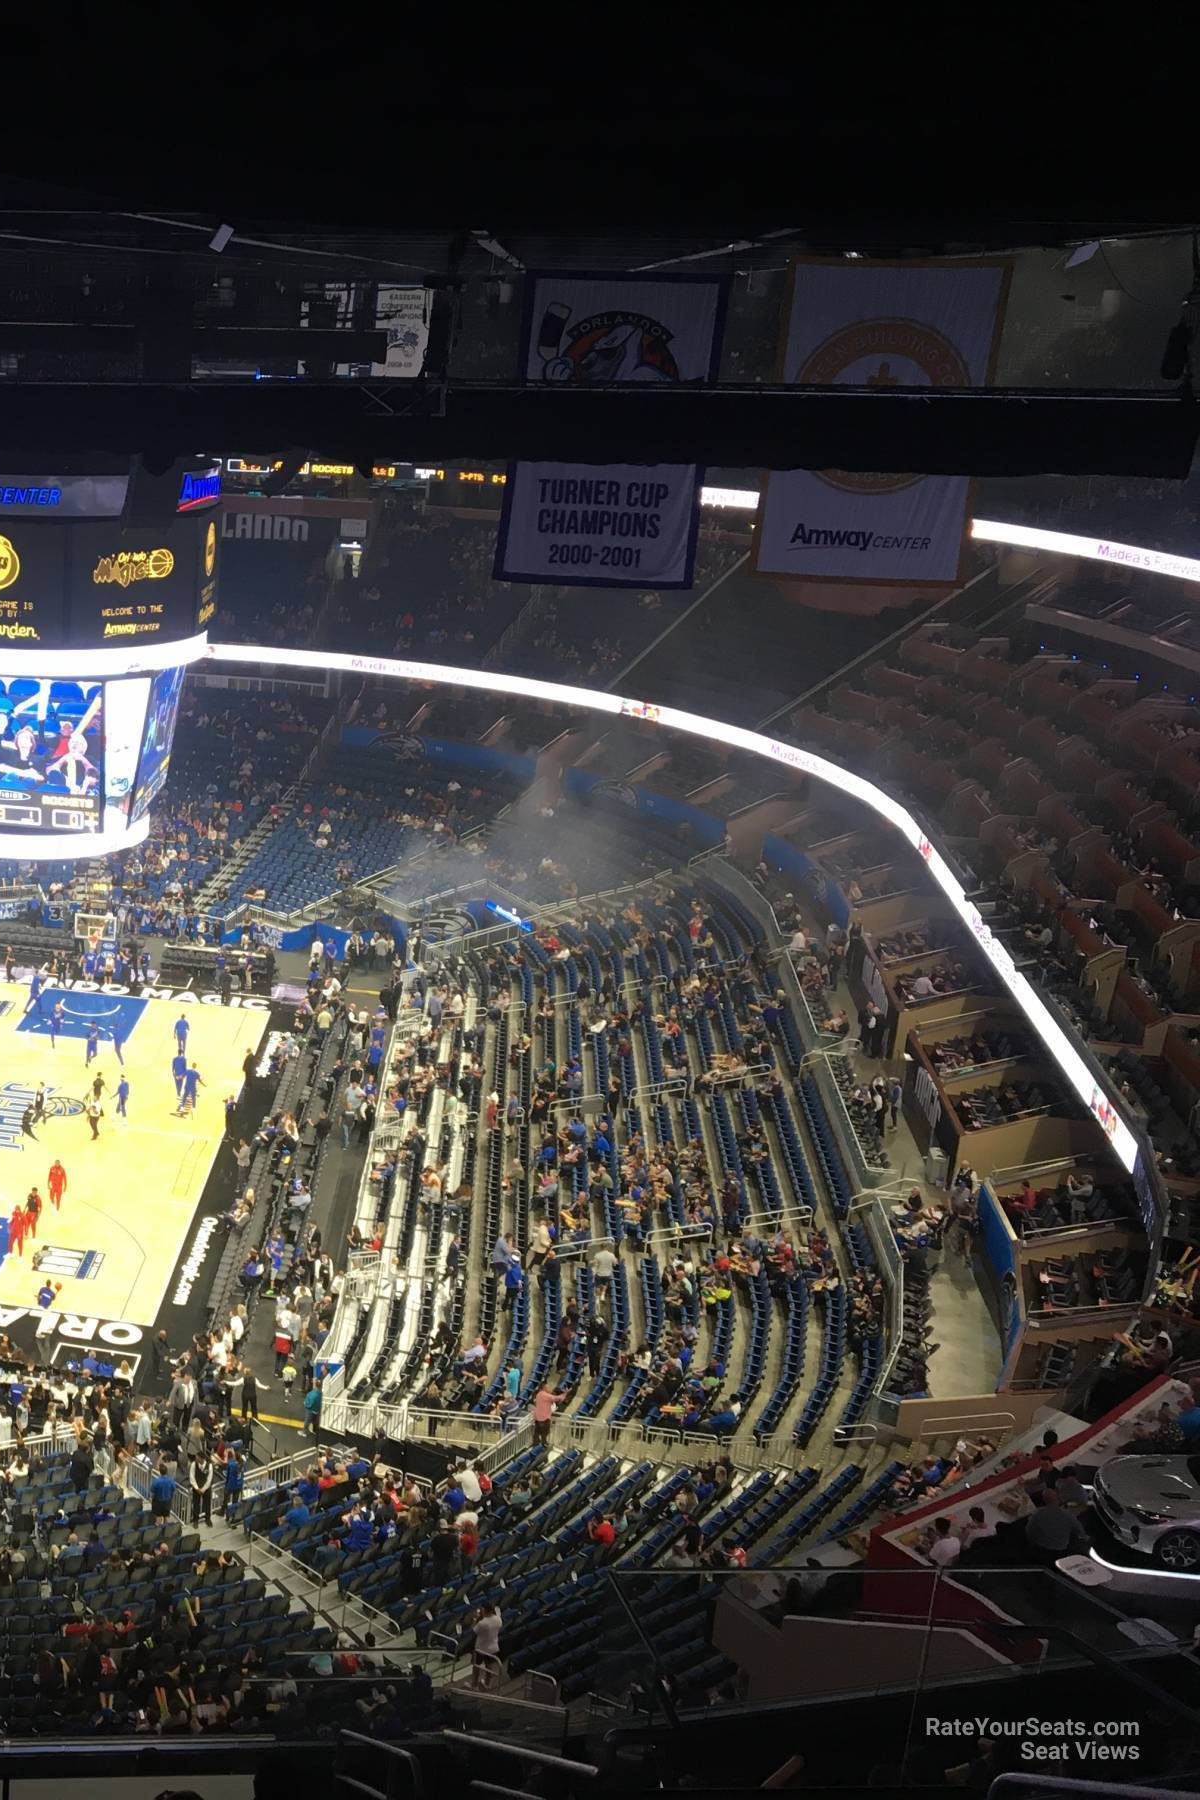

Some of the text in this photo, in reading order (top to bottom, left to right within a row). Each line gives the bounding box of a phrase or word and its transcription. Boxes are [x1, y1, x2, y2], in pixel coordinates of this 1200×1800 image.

[311, 465, 353, 475] ROCKETS
[538, 478, 669, 510] TURNER CUP
[221, 512, 309, 541] LANDO
[537, 509, 660, 540] CHAMPIONS
[791, 523, 931, 552] Amway CENTER
[548, 544, 641, 568] 2000-2001
[1097, 544, 1200, 577] Madea's Farewe
[23, 602, 33, 610] IS
[101, 604, 164, 617] WELCOME TO THE
[103, 622, 161, 637] Amway CENTER
[141, 987, 270, 1011] MAGIC
